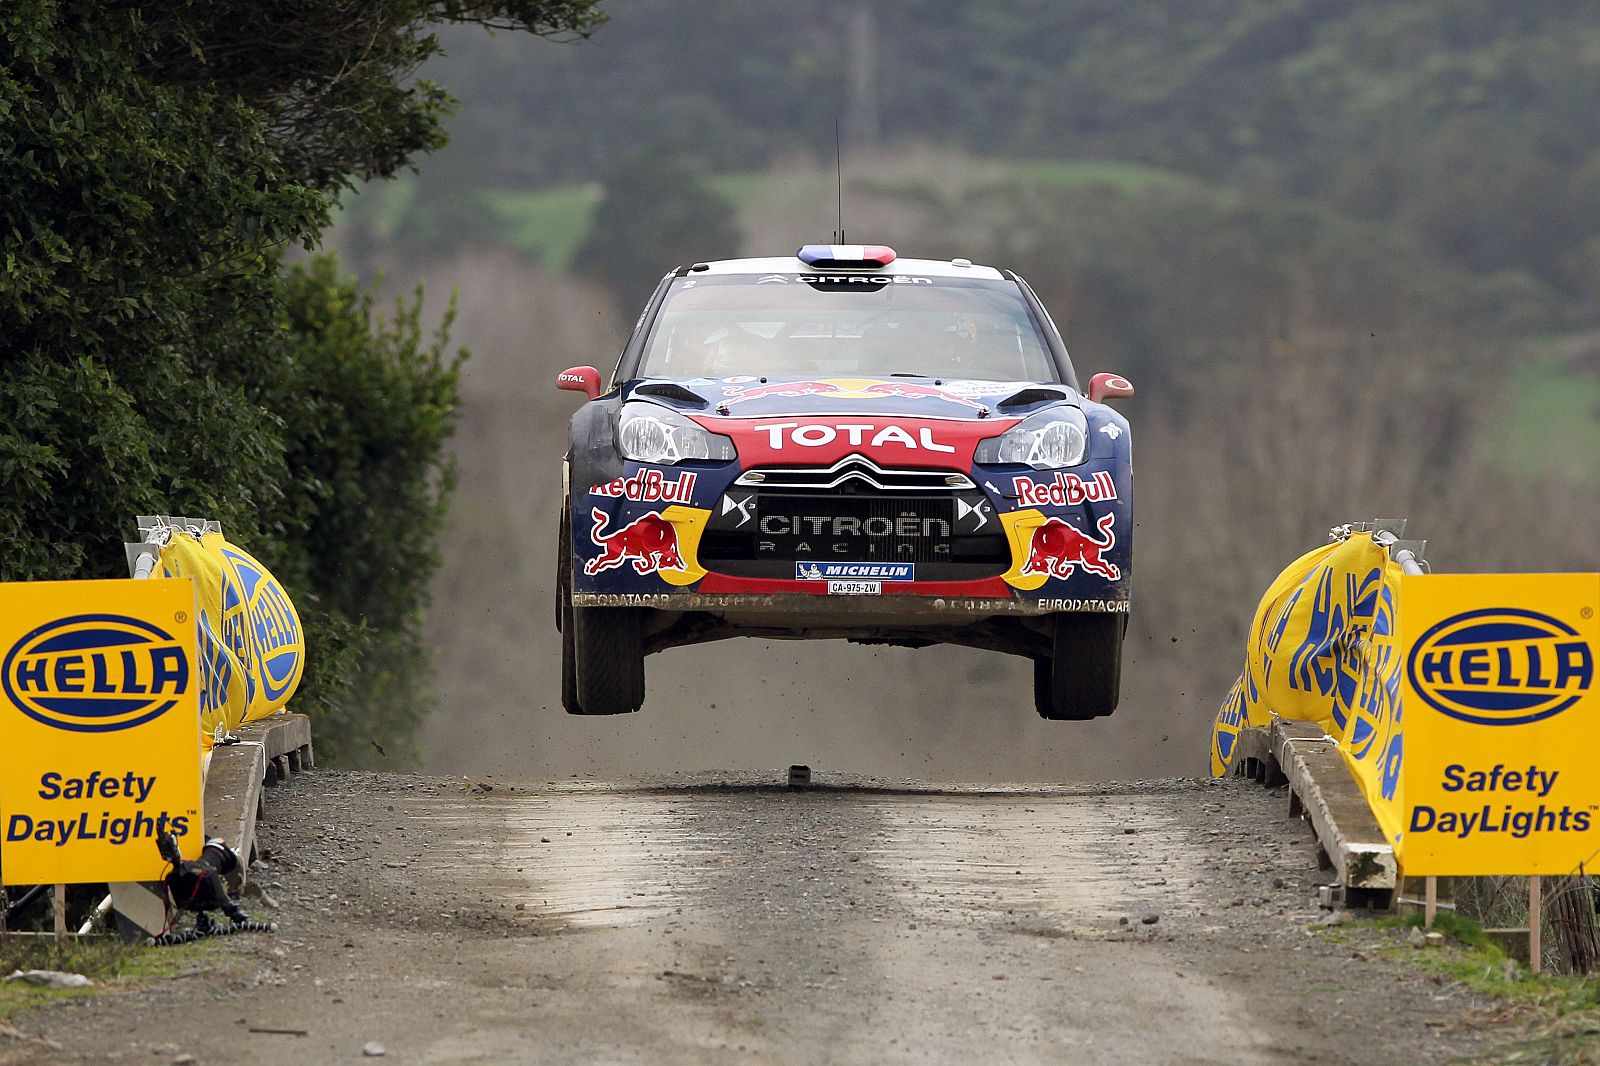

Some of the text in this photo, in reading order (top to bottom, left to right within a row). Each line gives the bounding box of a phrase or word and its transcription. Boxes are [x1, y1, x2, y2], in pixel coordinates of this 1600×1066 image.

[558, 373, 585, 383] TOTAL
[754, 422, 956, 454] TOTAL
[643, 470, 698, 505] Bull
[1012, 470, 1118, 508] Red Bull
[825, 565, 909, 577] MICHELIN
[832, 582, 877, 594] CA-975-ZW
[251, 580, 300, 654] HELLA
[1038, 599, 1130, 612] EURODATACAR
[16, 646, 189, 694] HELLA
[1422, 641, 1594, 690] HELLA
[38, 771, 156, 803] Safety
[1442, 764, 1560, 797] Safety
[7, 811, 188, 846] DayLights
[1409, 805, 1591, 838] DayLights
